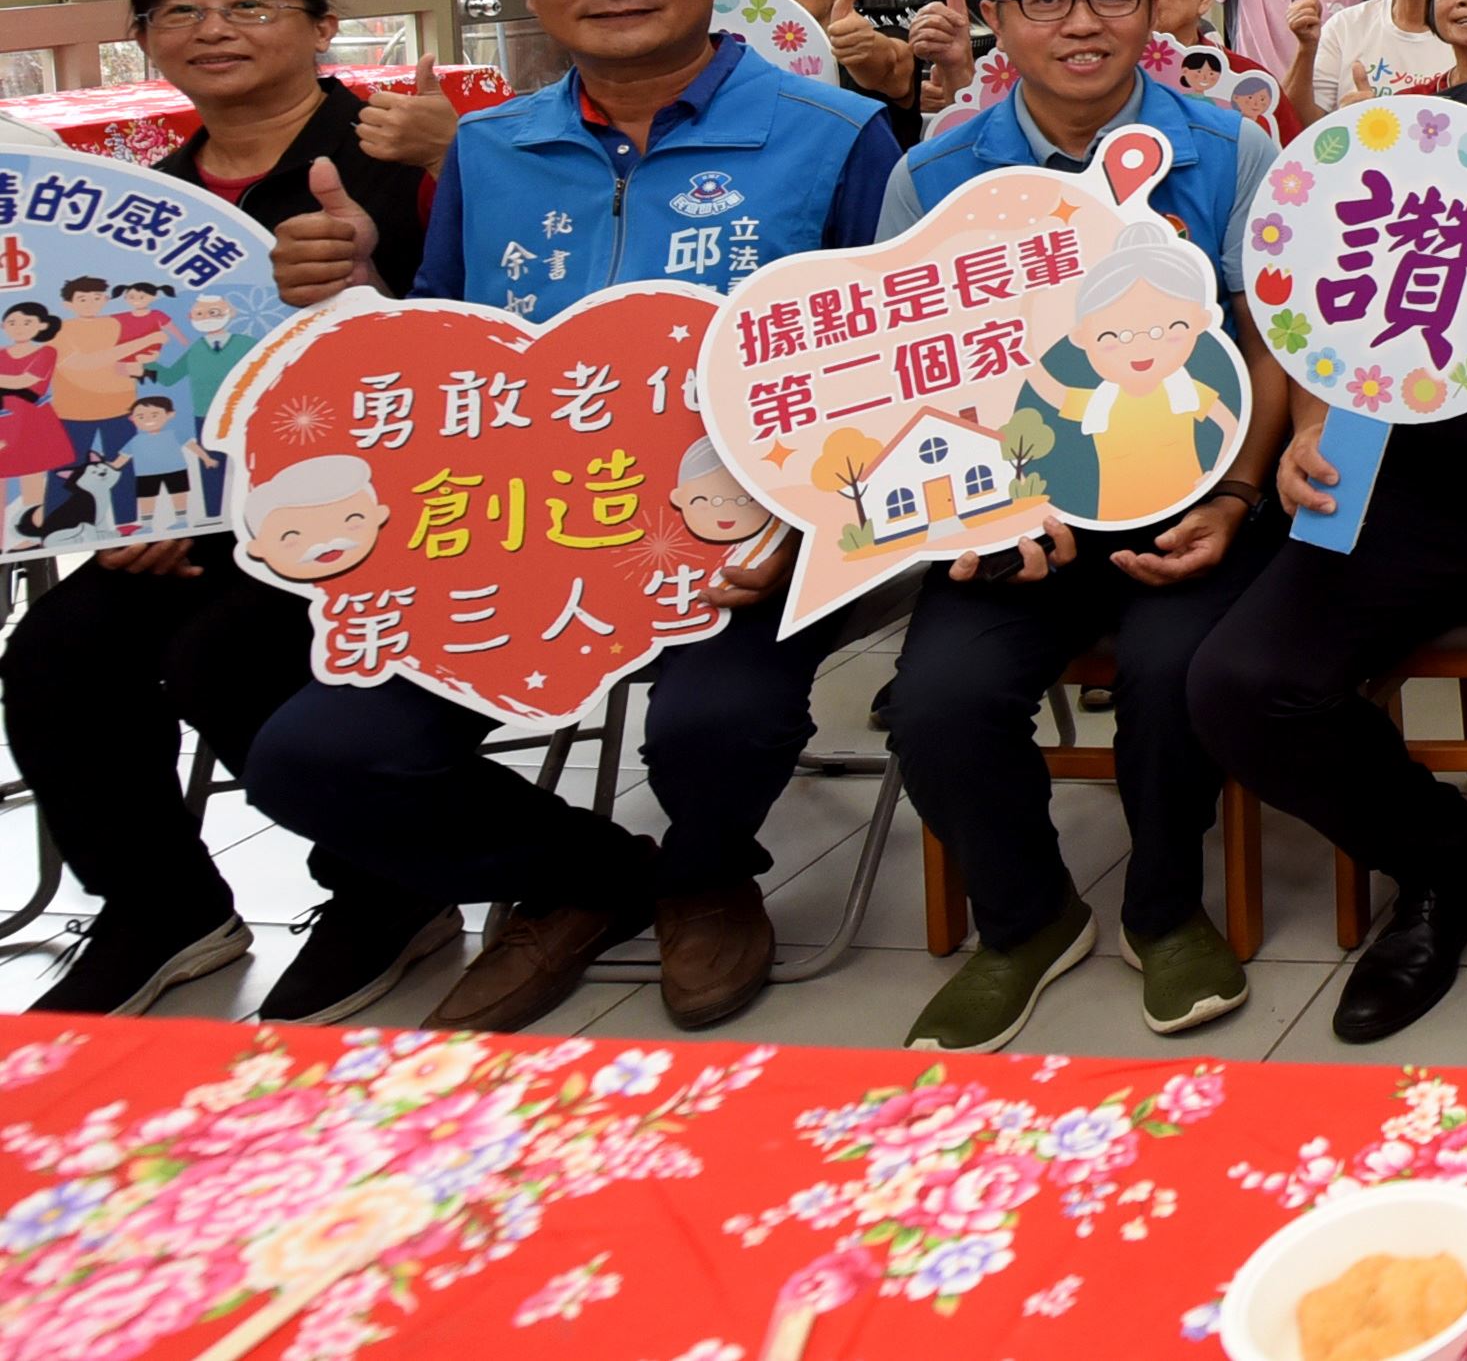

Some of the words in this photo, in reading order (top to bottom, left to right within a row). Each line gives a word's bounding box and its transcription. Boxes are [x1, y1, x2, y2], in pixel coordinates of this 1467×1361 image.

[542, 210, 573, 280] 秘書
[664, 226, 722, 291] 邱
[737, 229, 1084, 368] 據點是長輩
[748, 318, 1032, 442] 第二個家
[407, 448, 646, 560] 創造
[329, 563, 719, 671] 第三人生
